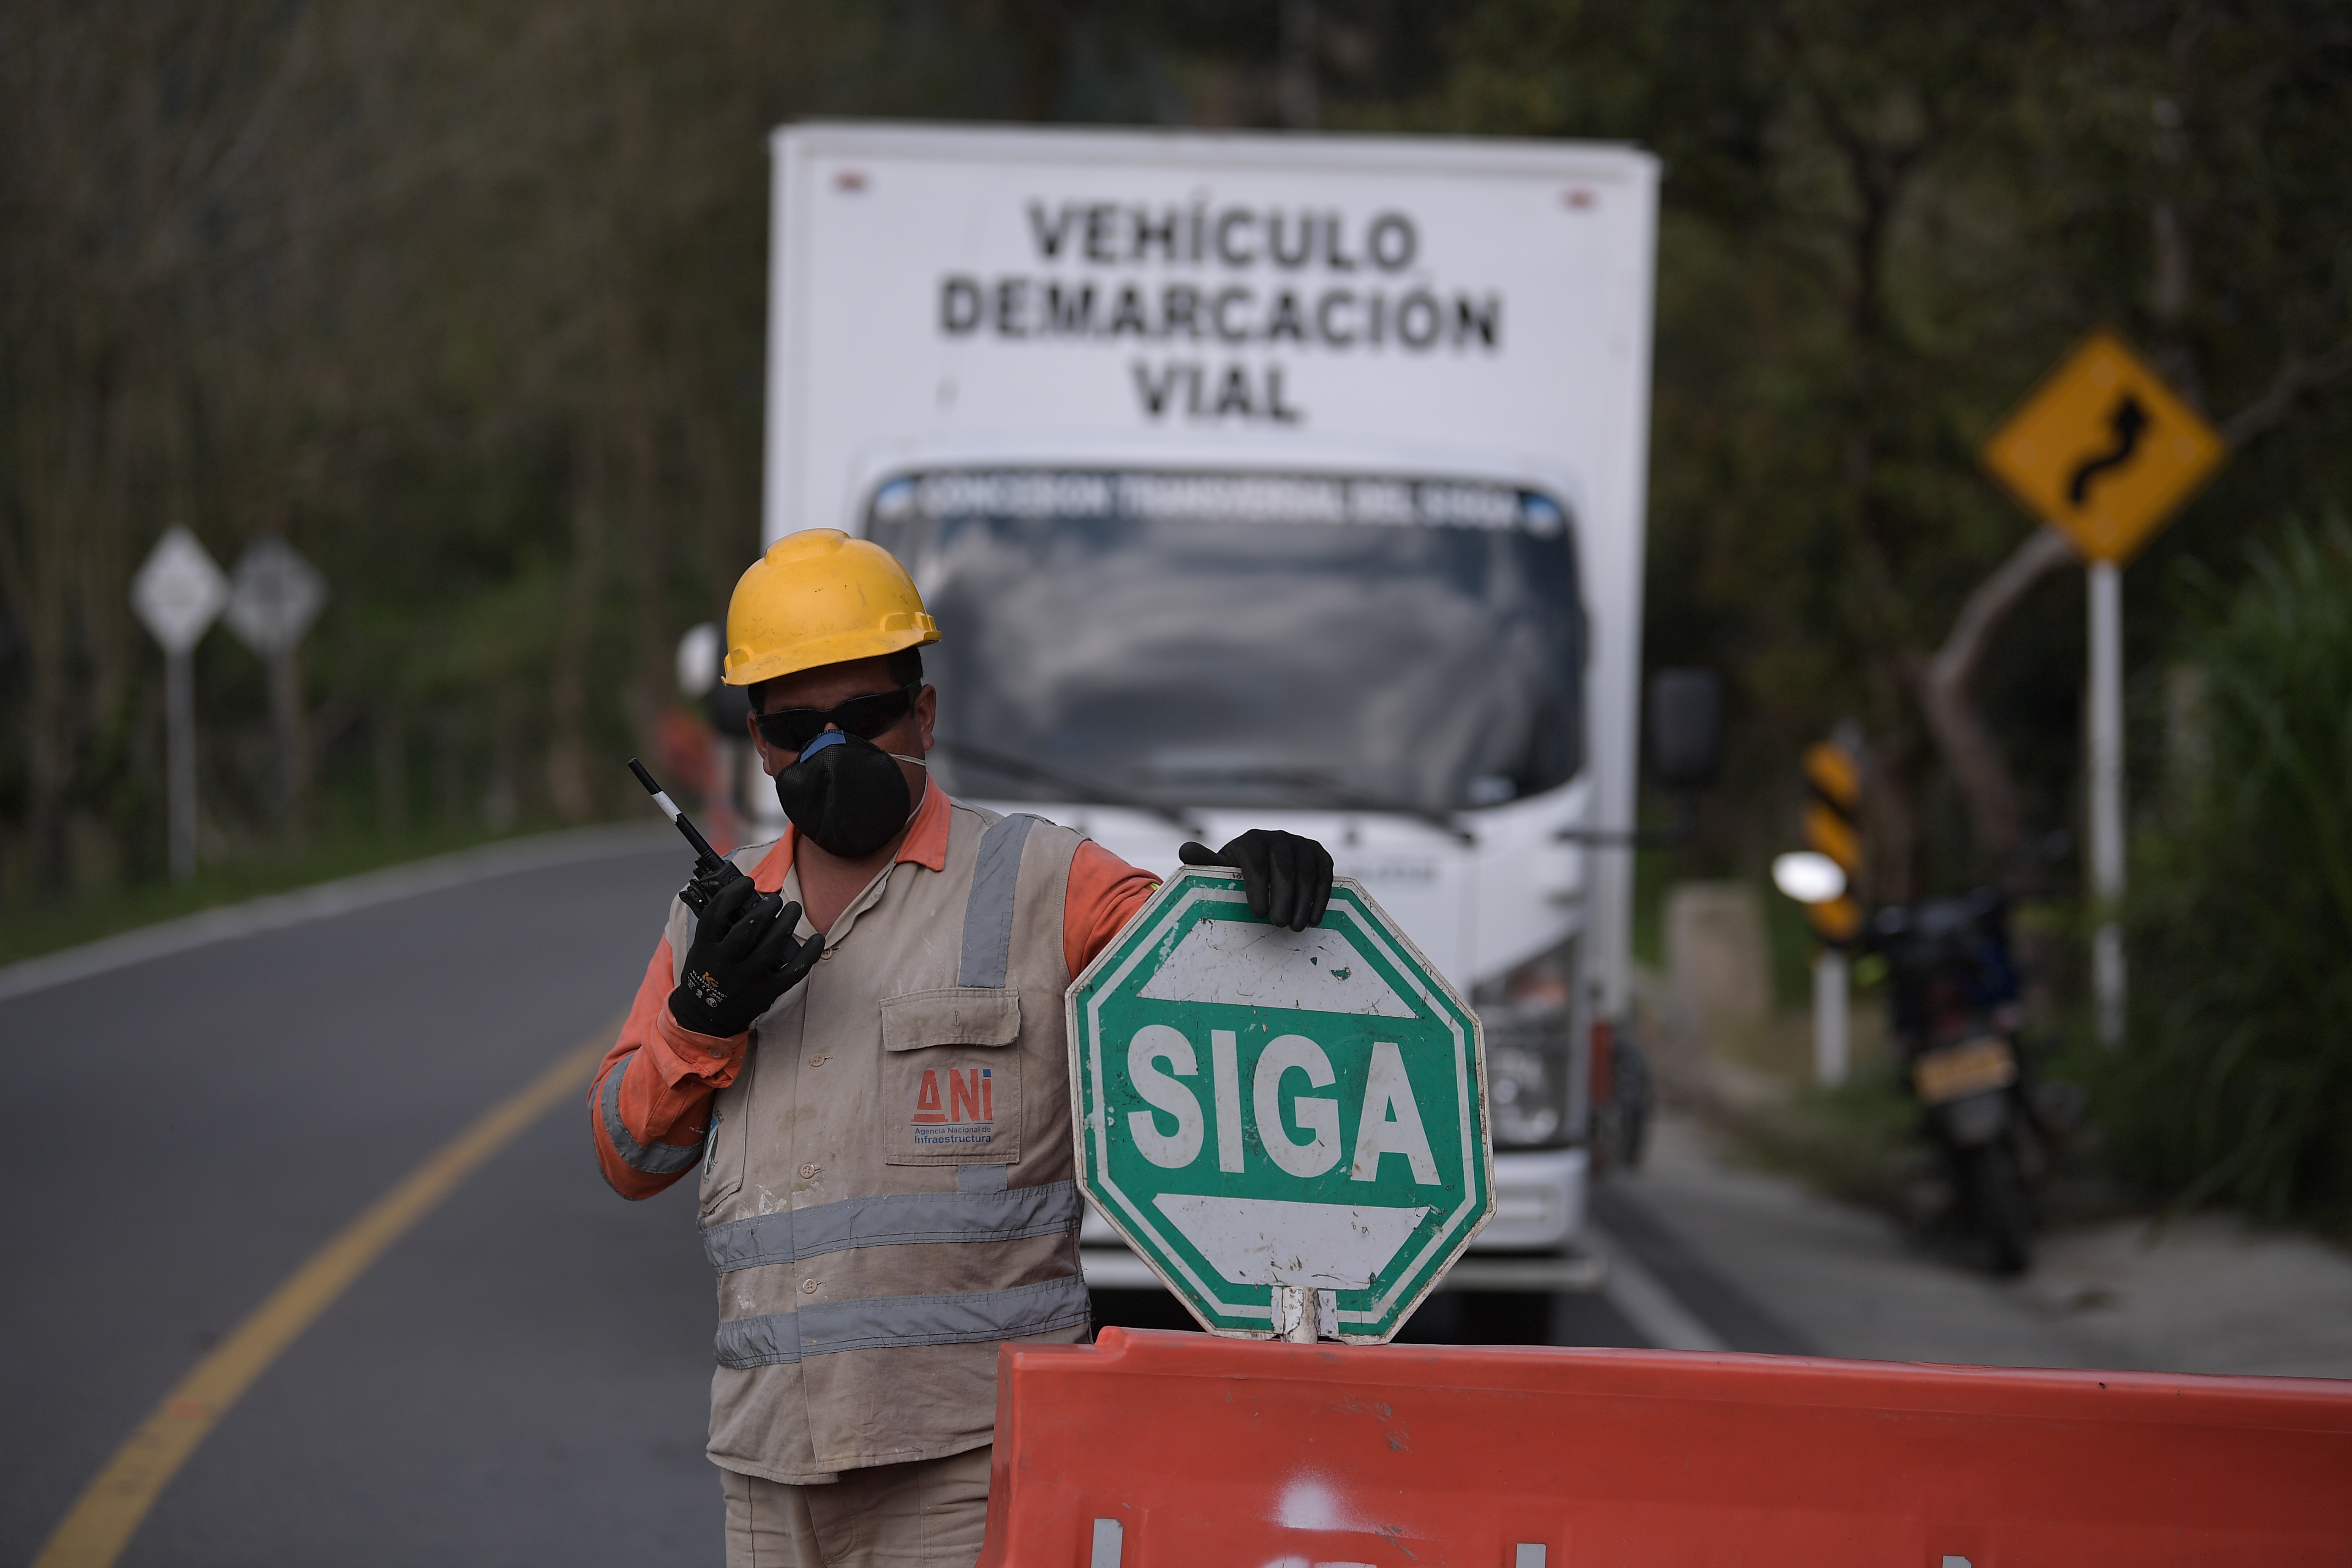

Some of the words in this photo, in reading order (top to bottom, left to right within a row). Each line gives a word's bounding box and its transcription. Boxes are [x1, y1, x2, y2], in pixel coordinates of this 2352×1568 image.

[1028, 191, 1420, 272] VEHÍCULO
[939, 275, 1504, 350] DEMARCACIÓN
[1130, 360, 1304, 423] VIAL
[915, 1135, 991, 1143] Infraestructura
[1127, 1024, 1441, 1185] SIGA
